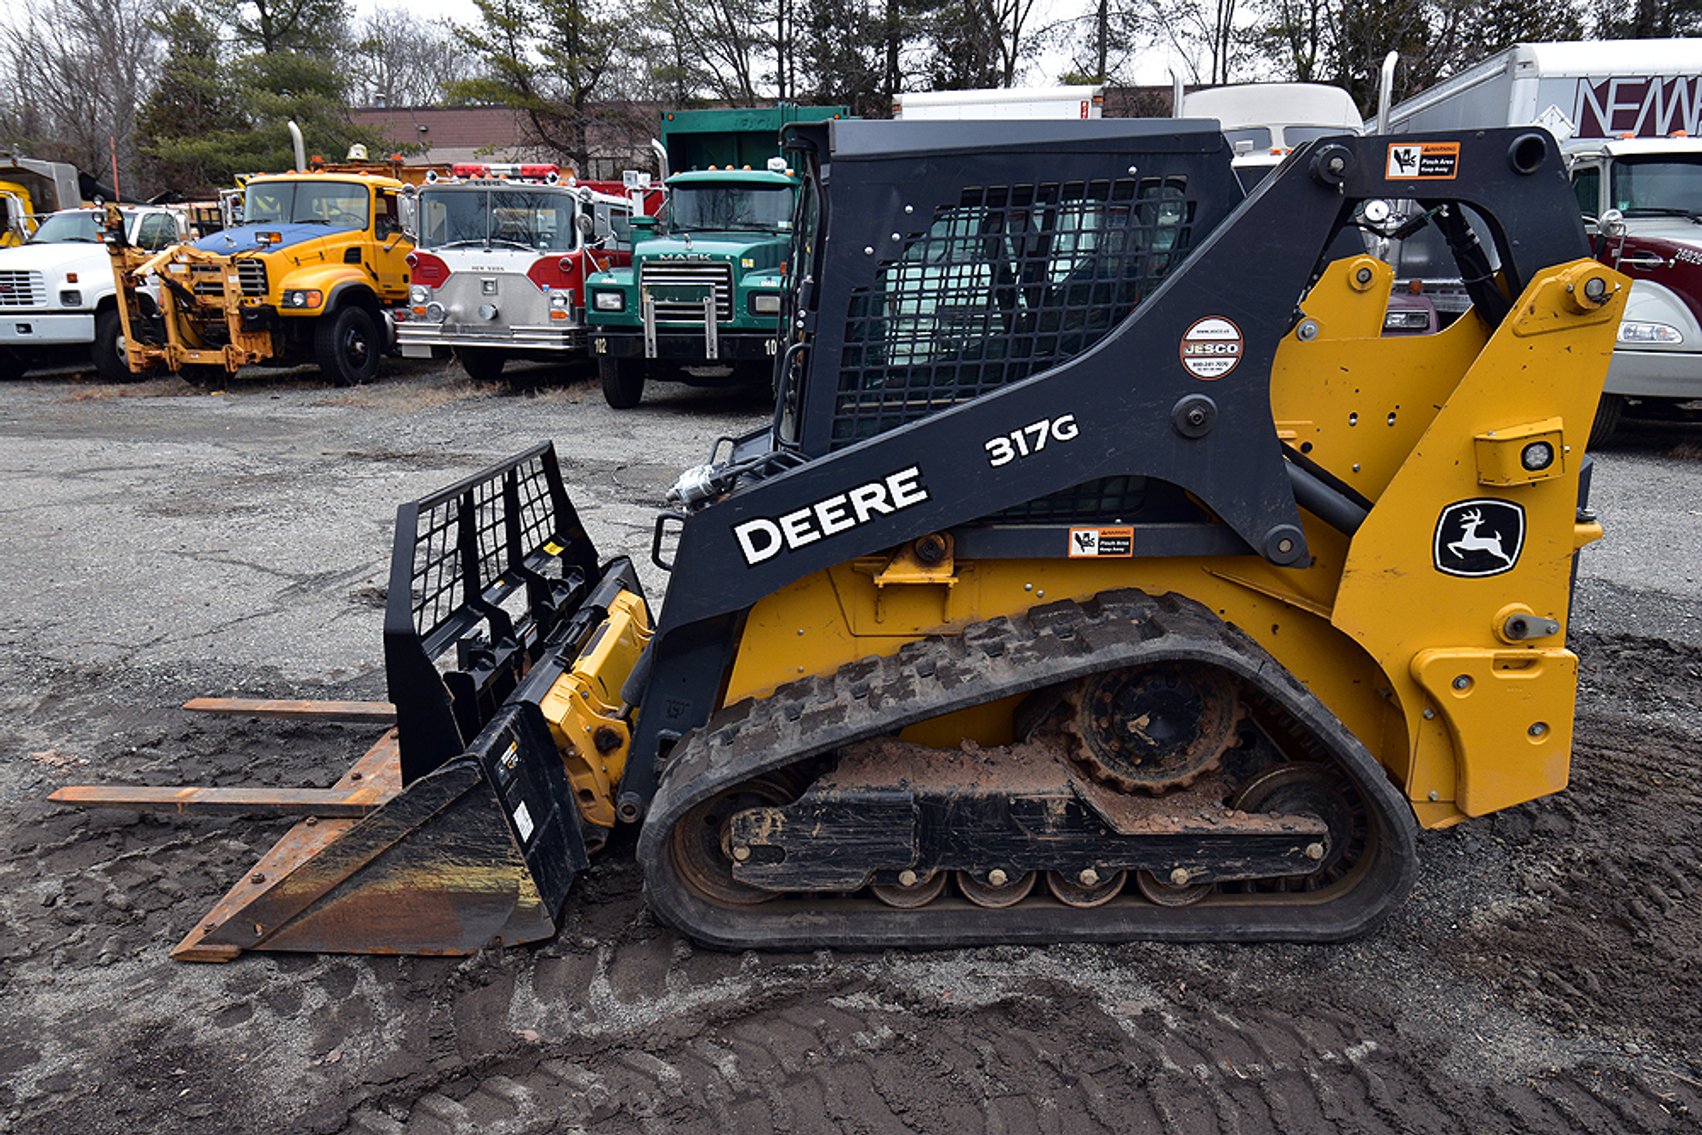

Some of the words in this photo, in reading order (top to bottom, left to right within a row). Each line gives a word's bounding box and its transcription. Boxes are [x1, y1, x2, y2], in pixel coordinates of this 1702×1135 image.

[658, 253, 712, 261] MACK
[594, 338, 607, 354] 102
[764, 339, 777, 355] 10
[1184, 342, 1239, 354] JESCO
[985, 414, 1078, 467] 317G
[734, 465, 929, 566] DEERE
